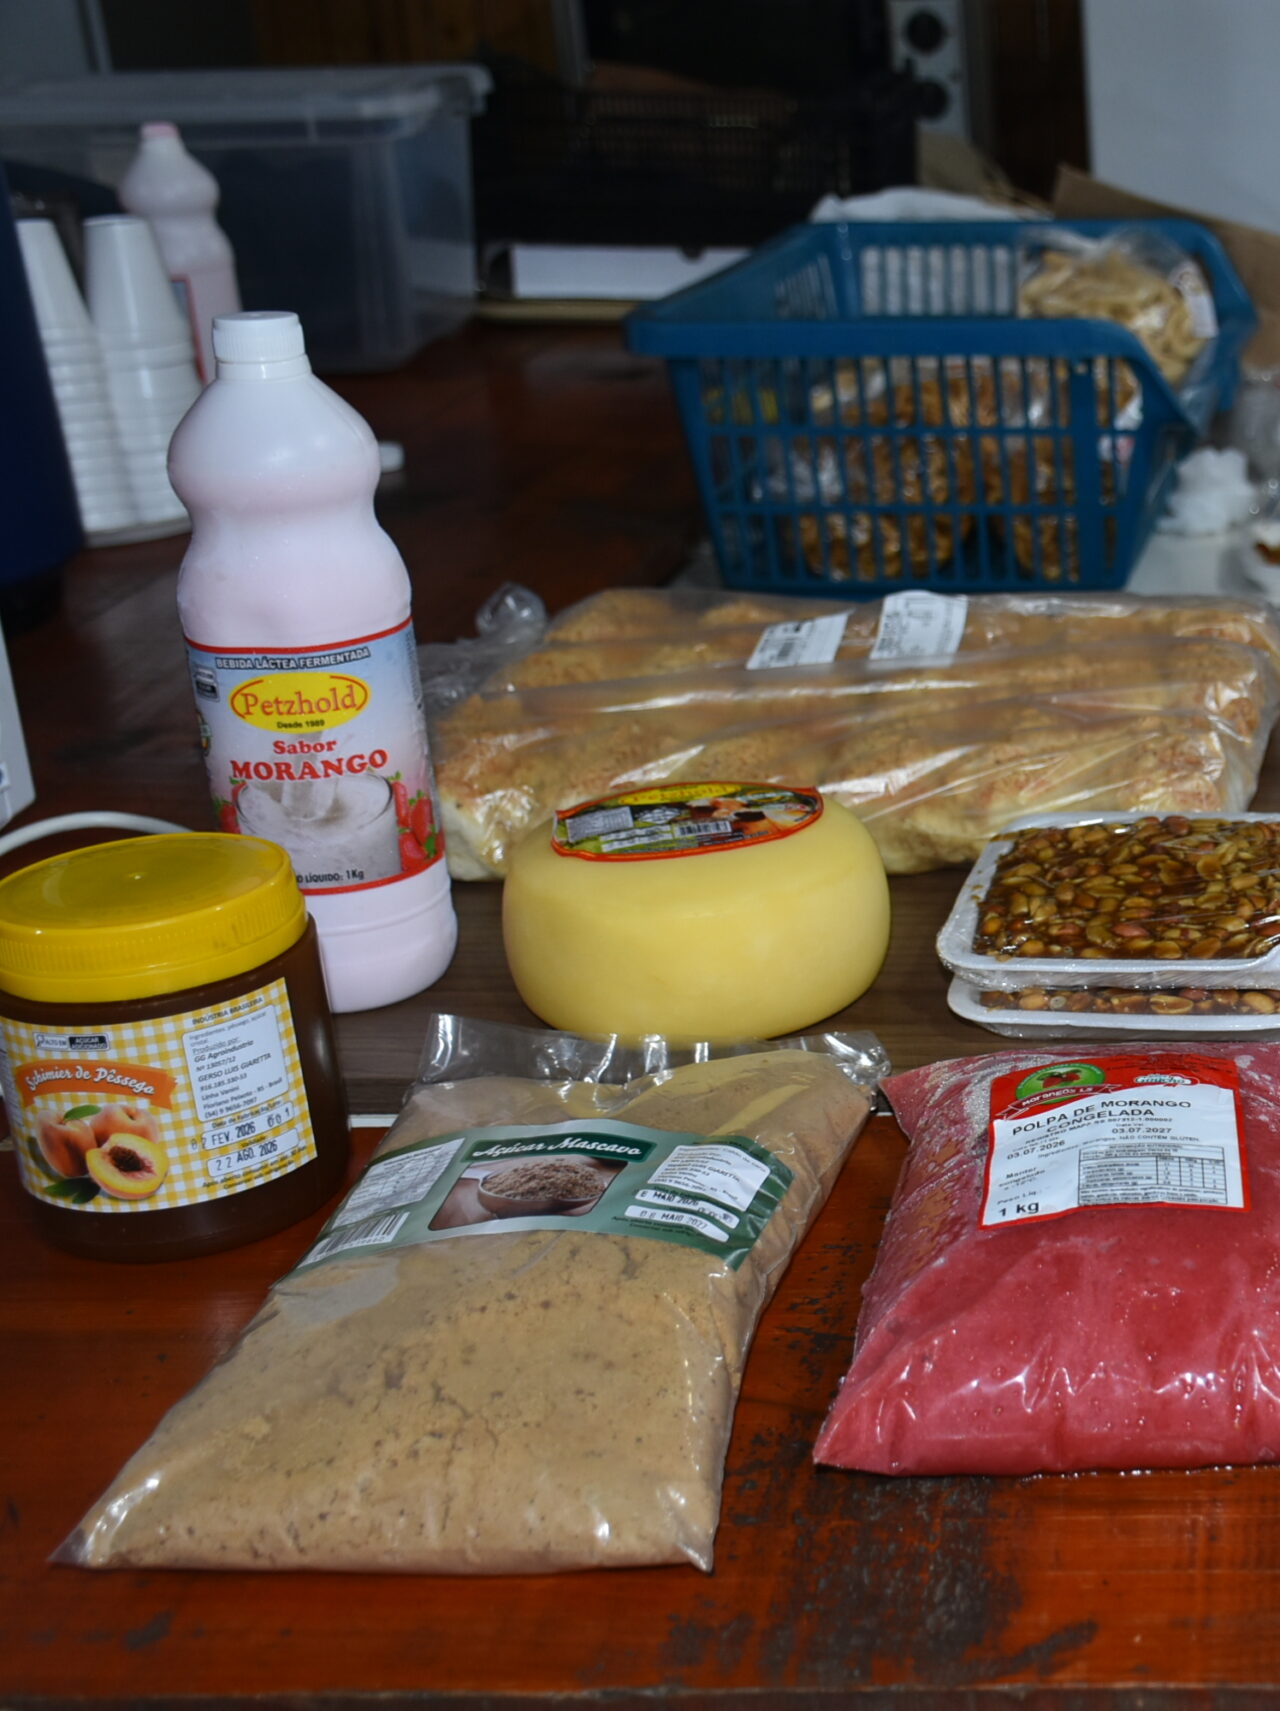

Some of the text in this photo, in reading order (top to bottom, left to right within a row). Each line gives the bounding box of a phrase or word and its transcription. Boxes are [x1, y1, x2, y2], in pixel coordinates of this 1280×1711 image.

[215, 648, 371, 669] BEBIDA LÁCTEA FERMENTADA
[240, 684, 358, 716] Petzhold
[277, 720, 303, 730] Desde
[273, 740, 338, 755] Sabor
[230, 749, 389, 782] MORANGO
[304, 871, 344, 884] LÍQUIDO:
[75, 1066, 91, 1080] de
[224, 1066, 240, 1077] LUIS
[1022, 1088, 1076, 1107] Morangos
[1012, 1100, 1192, 1136] POLPA DE MORANGO
[1046, 1109, 1155, 1133] CONGELADA
[235, 1121, 256, 1138] 2026
[1111, 1127, 1173, 1135] 03.07.2027
[259, 1140, 278, 1157] 2026
[472, 1136, 643, 1158] Açúcar Mascavo
[661, 1212, 685, 1222] MAIO
[999, 1201, 1040, 1217] 1 kg
